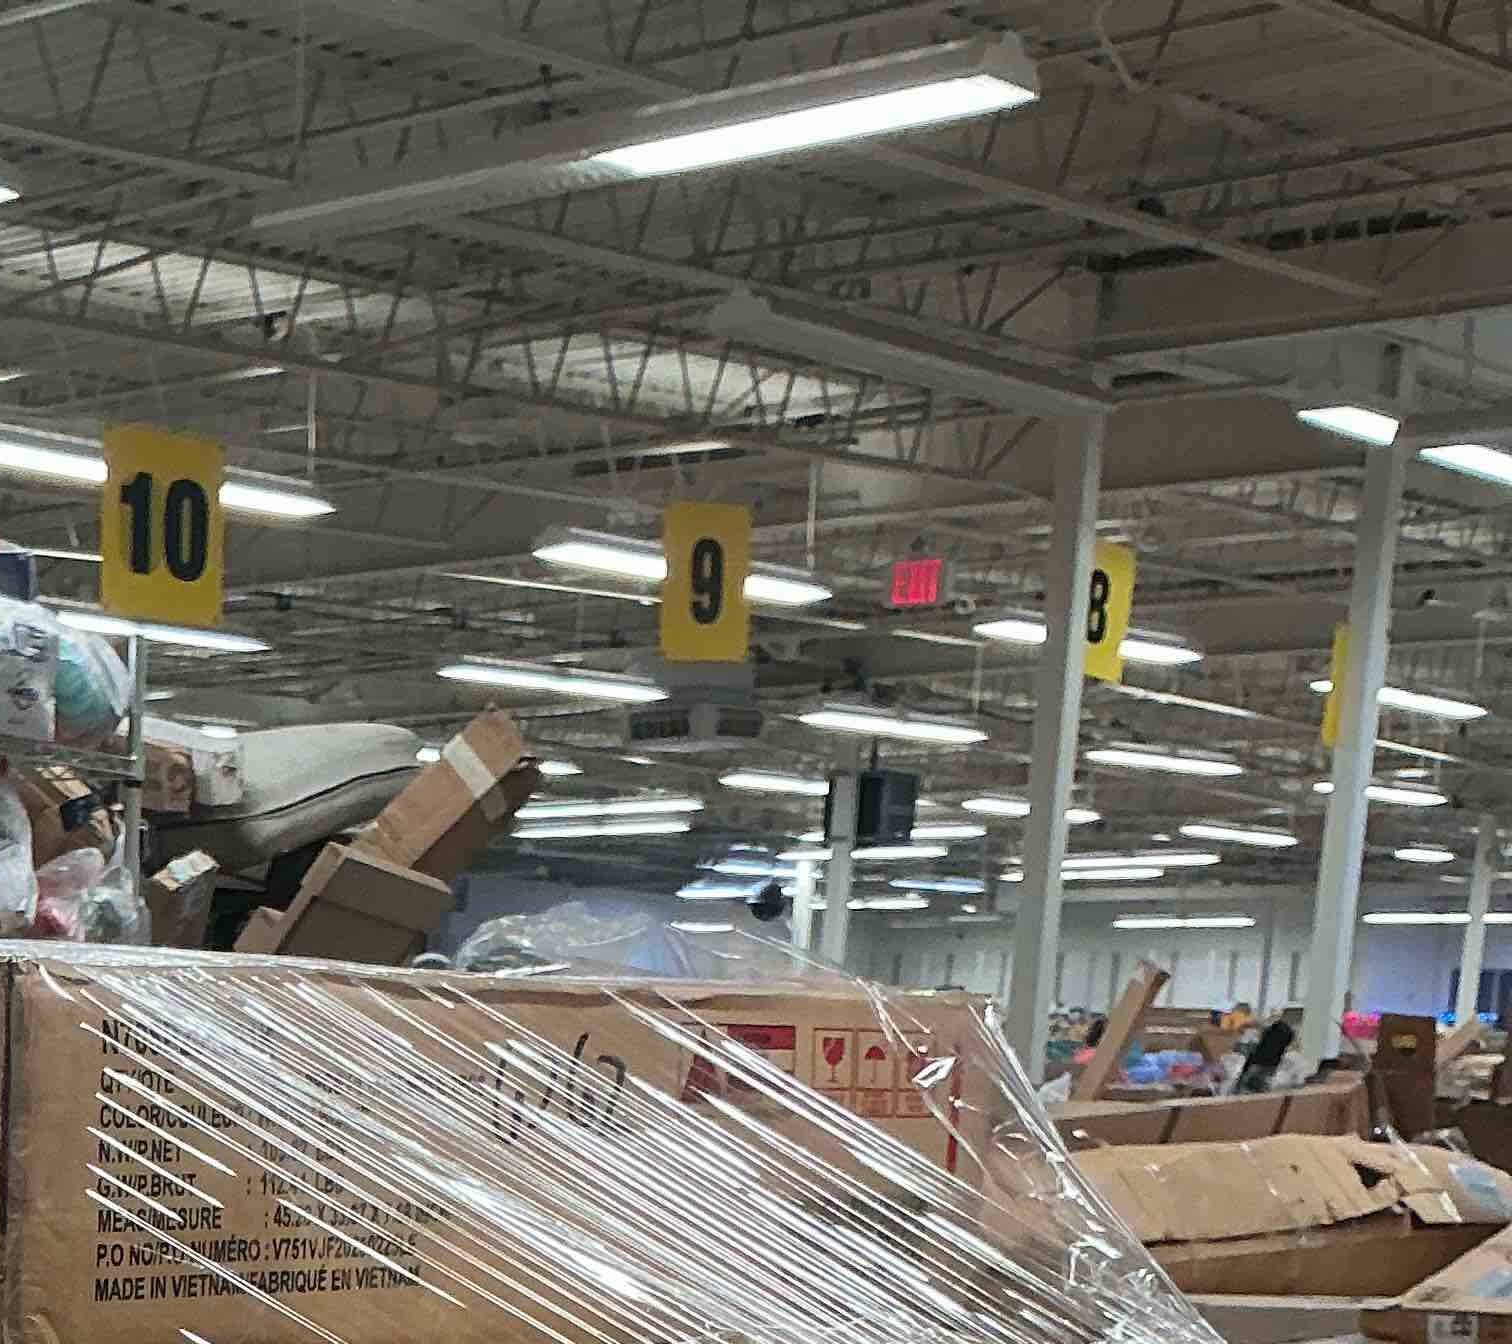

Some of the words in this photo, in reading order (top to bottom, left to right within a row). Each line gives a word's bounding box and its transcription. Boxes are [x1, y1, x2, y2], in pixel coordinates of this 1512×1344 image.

[120, 471, 209, 582] 10
[690, 537, 724, 625] 9
[1087, 568, 1109, 643] 8
[94, 1277, 146, 1302] MADE
[150, 1275, 167, 1299] IN
[331, 1266, 352, 1291] EN
[96, 1242, 125, 1268] P.O
